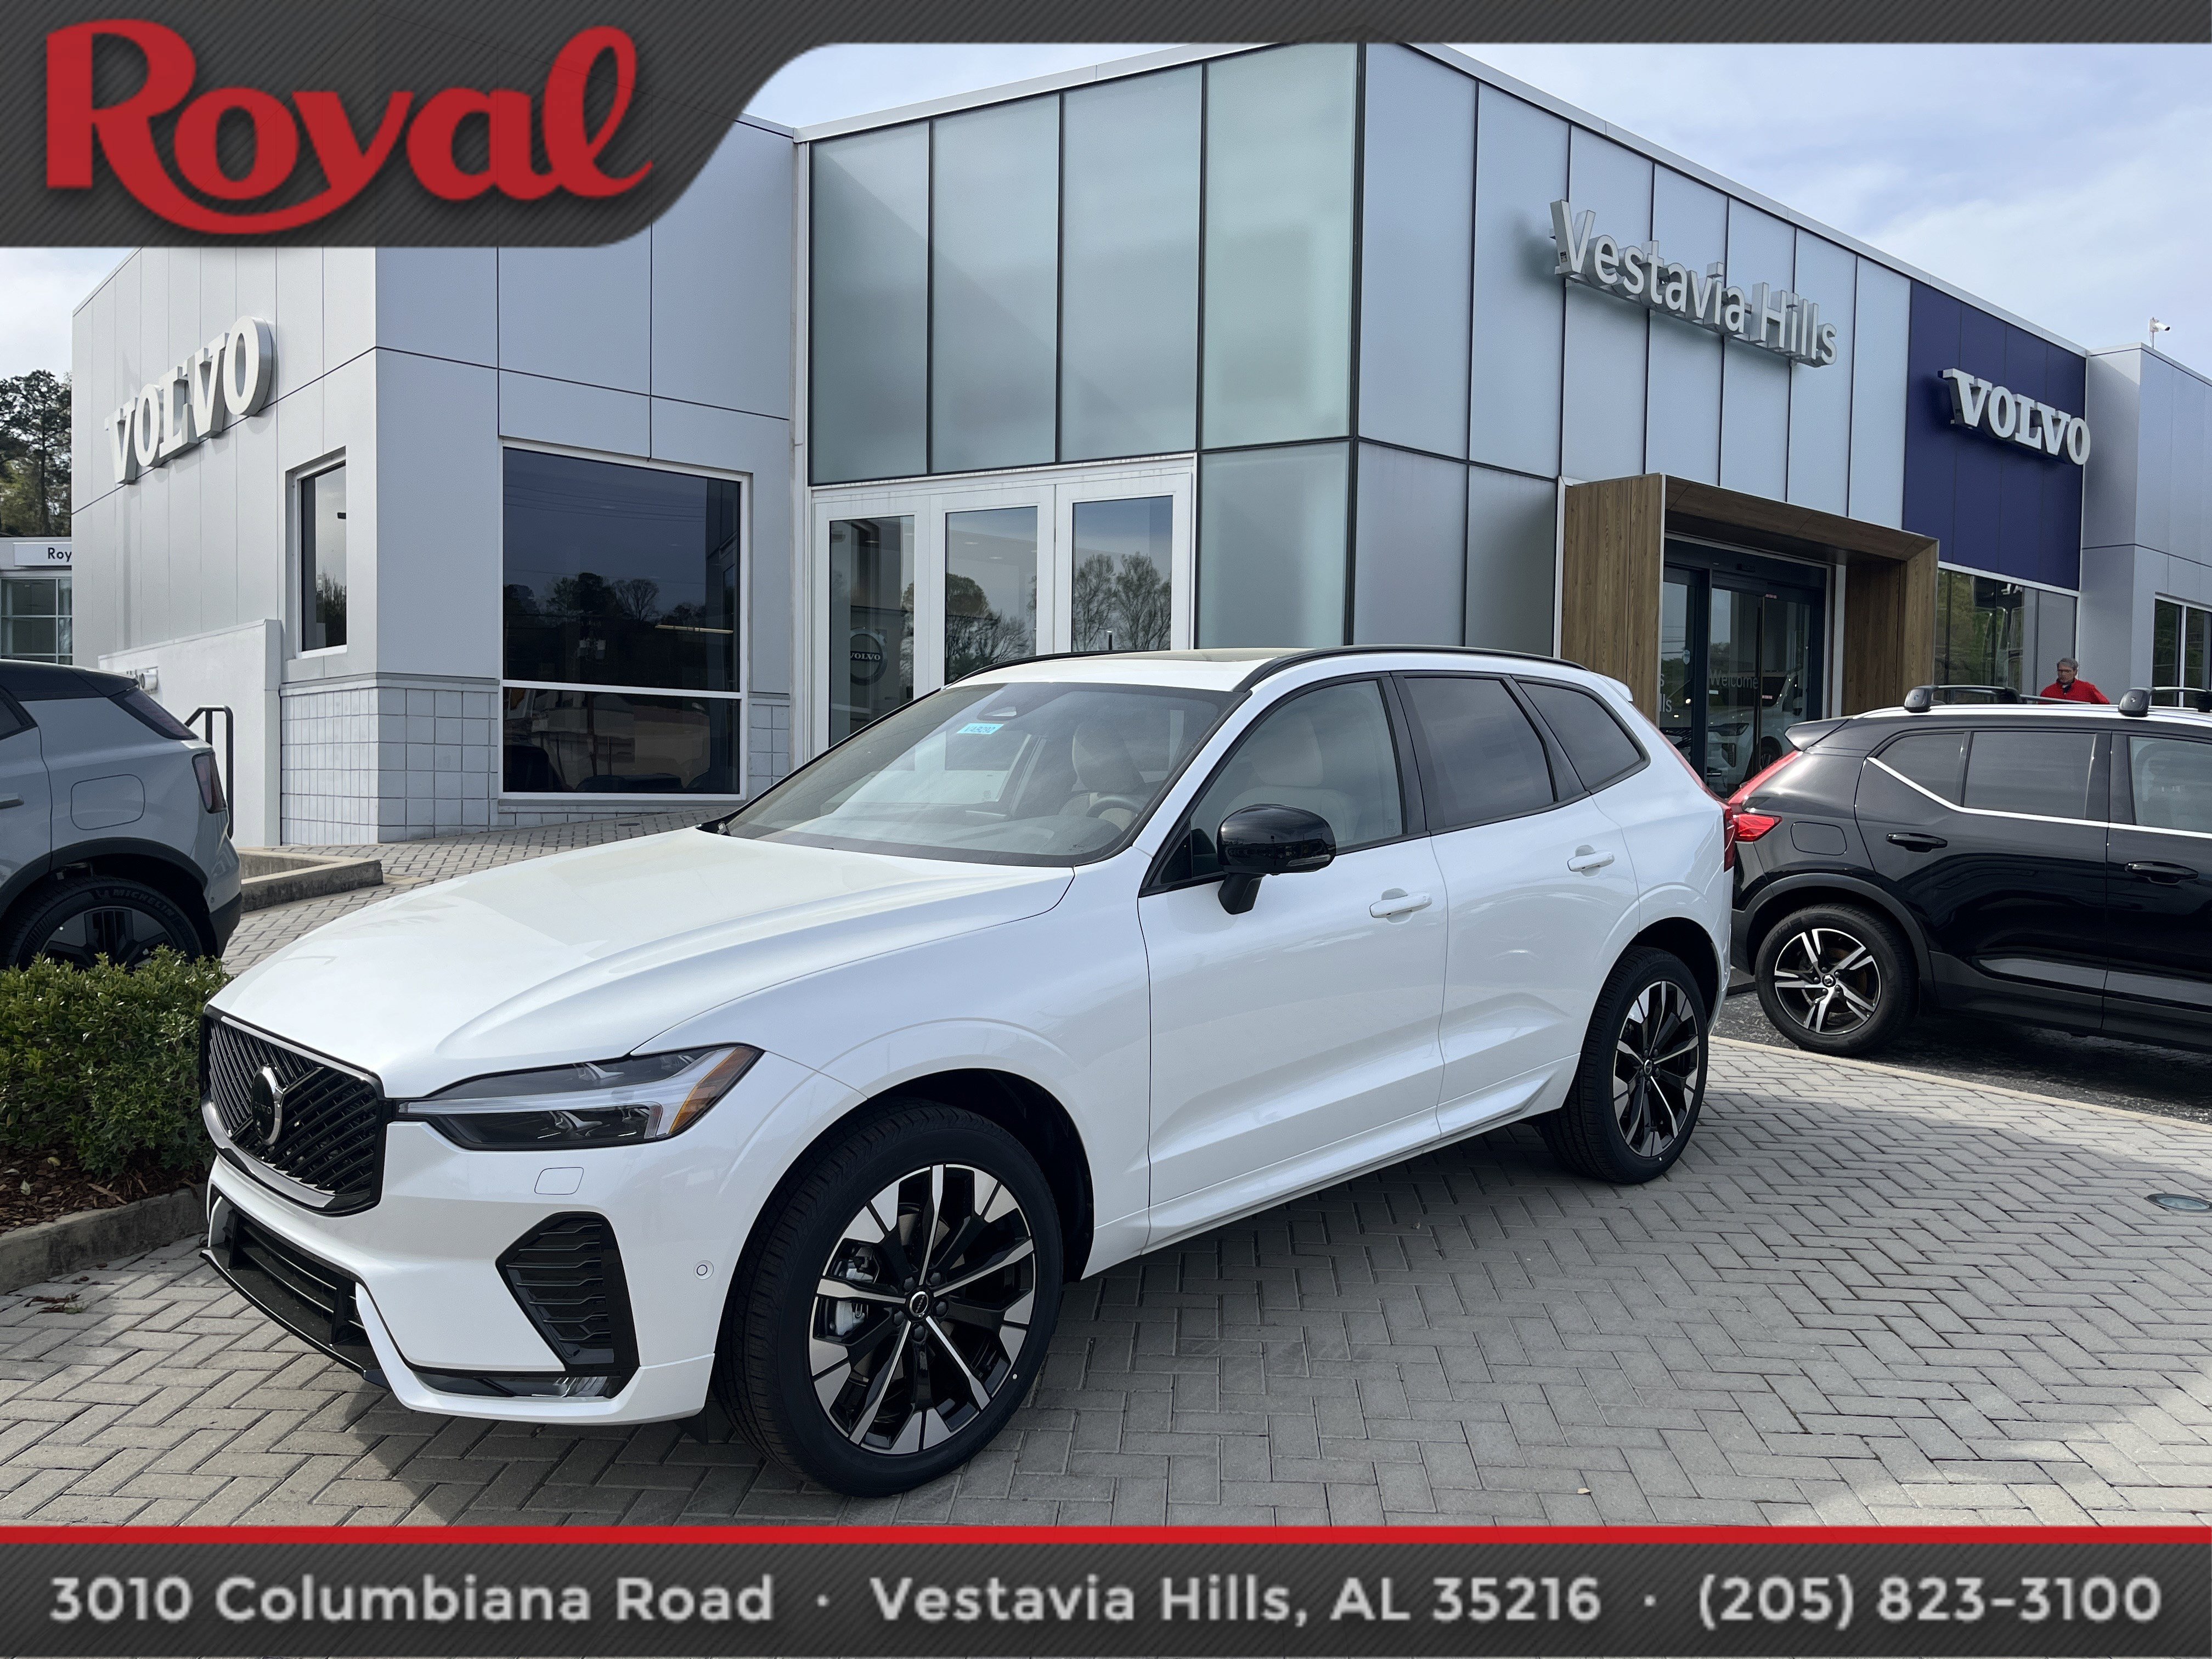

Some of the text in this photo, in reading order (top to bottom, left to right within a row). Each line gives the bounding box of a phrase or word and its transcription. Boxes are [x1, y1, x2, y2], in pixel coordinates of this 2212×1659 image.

[1550, 199, 1837, 368] Vestavia Hills
[105, 315, 271, 483] VOLVO
[1943, 368, 2091, 465] VOLVO
[1709, 669, 1759, 690] Welcome
